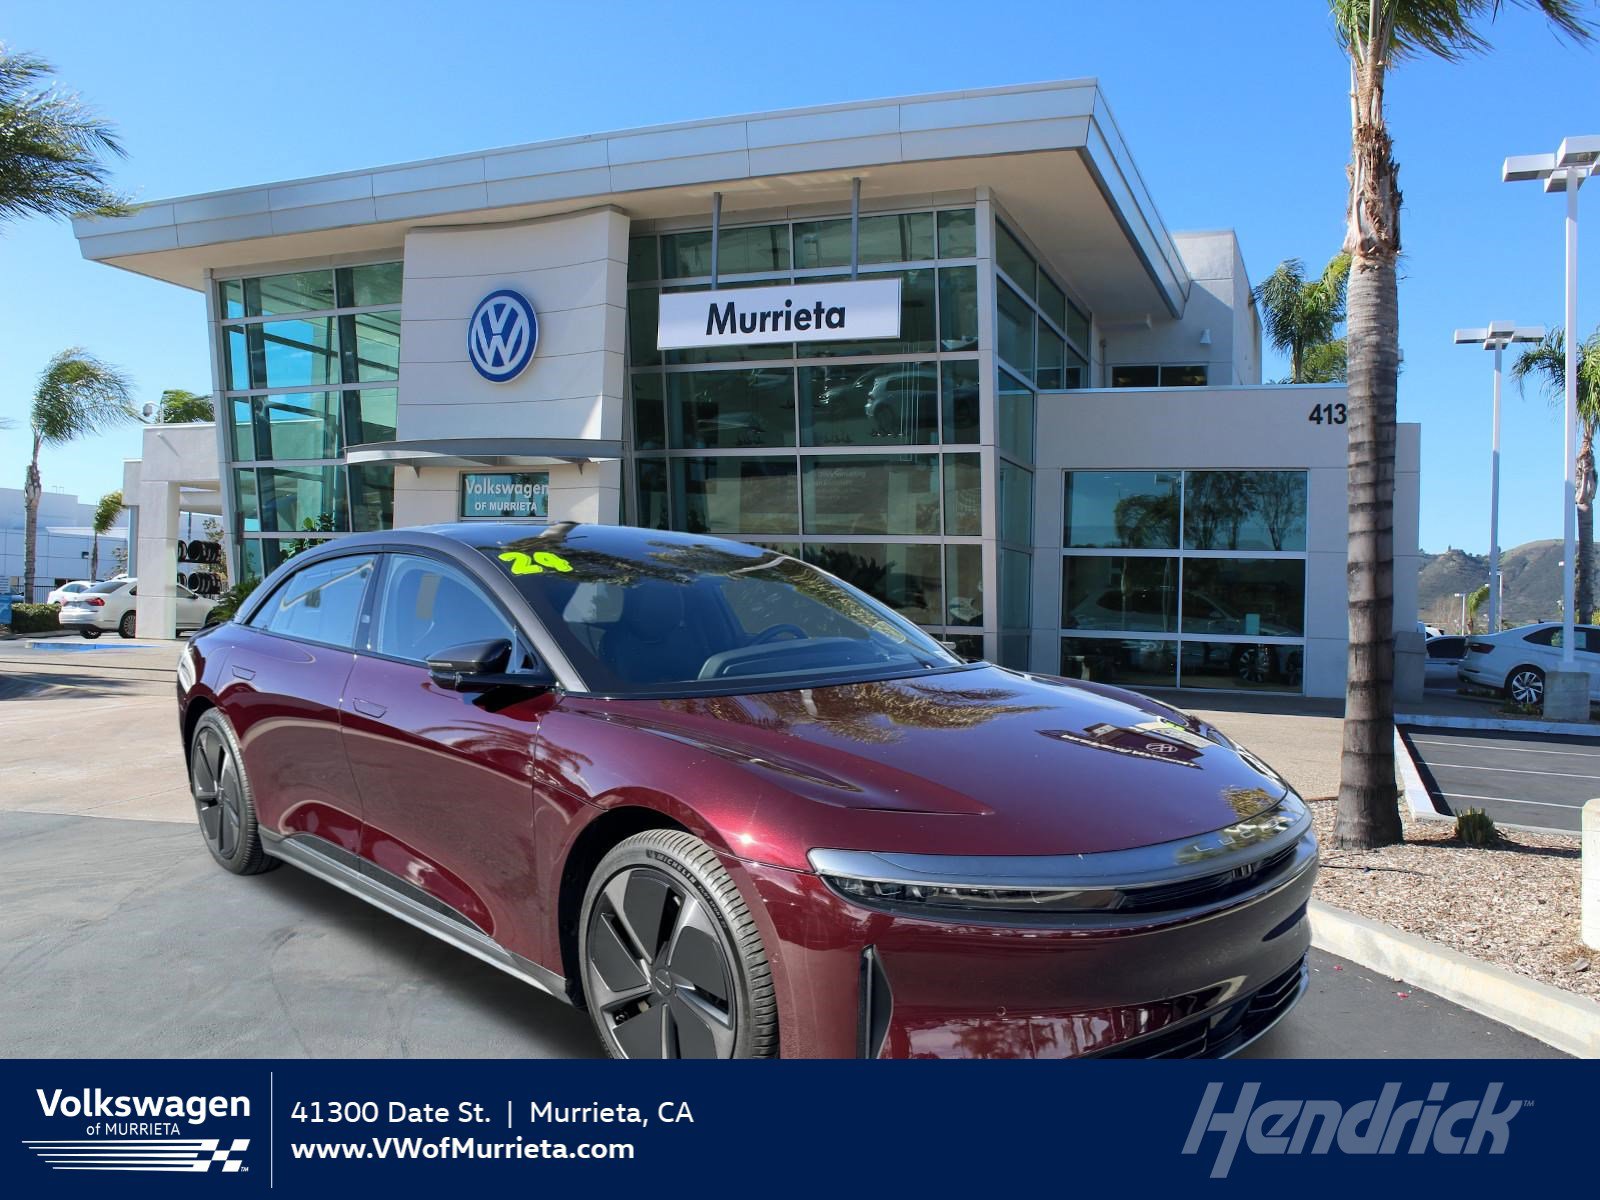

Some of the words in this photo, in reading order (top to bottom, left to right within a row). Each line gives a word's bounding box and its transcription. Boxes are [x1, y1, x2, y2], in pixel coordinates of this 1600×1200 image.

[705, 299, 846, 336] Murrieta
[1308, 403, 1347, 425] 413
[465, 478, 549, 497] Volkswagen
[474, 502, 487, 511] OF
[489, 501, 537, 511] MURRIETA
[655, 851, 697, 884] MICHELIN
